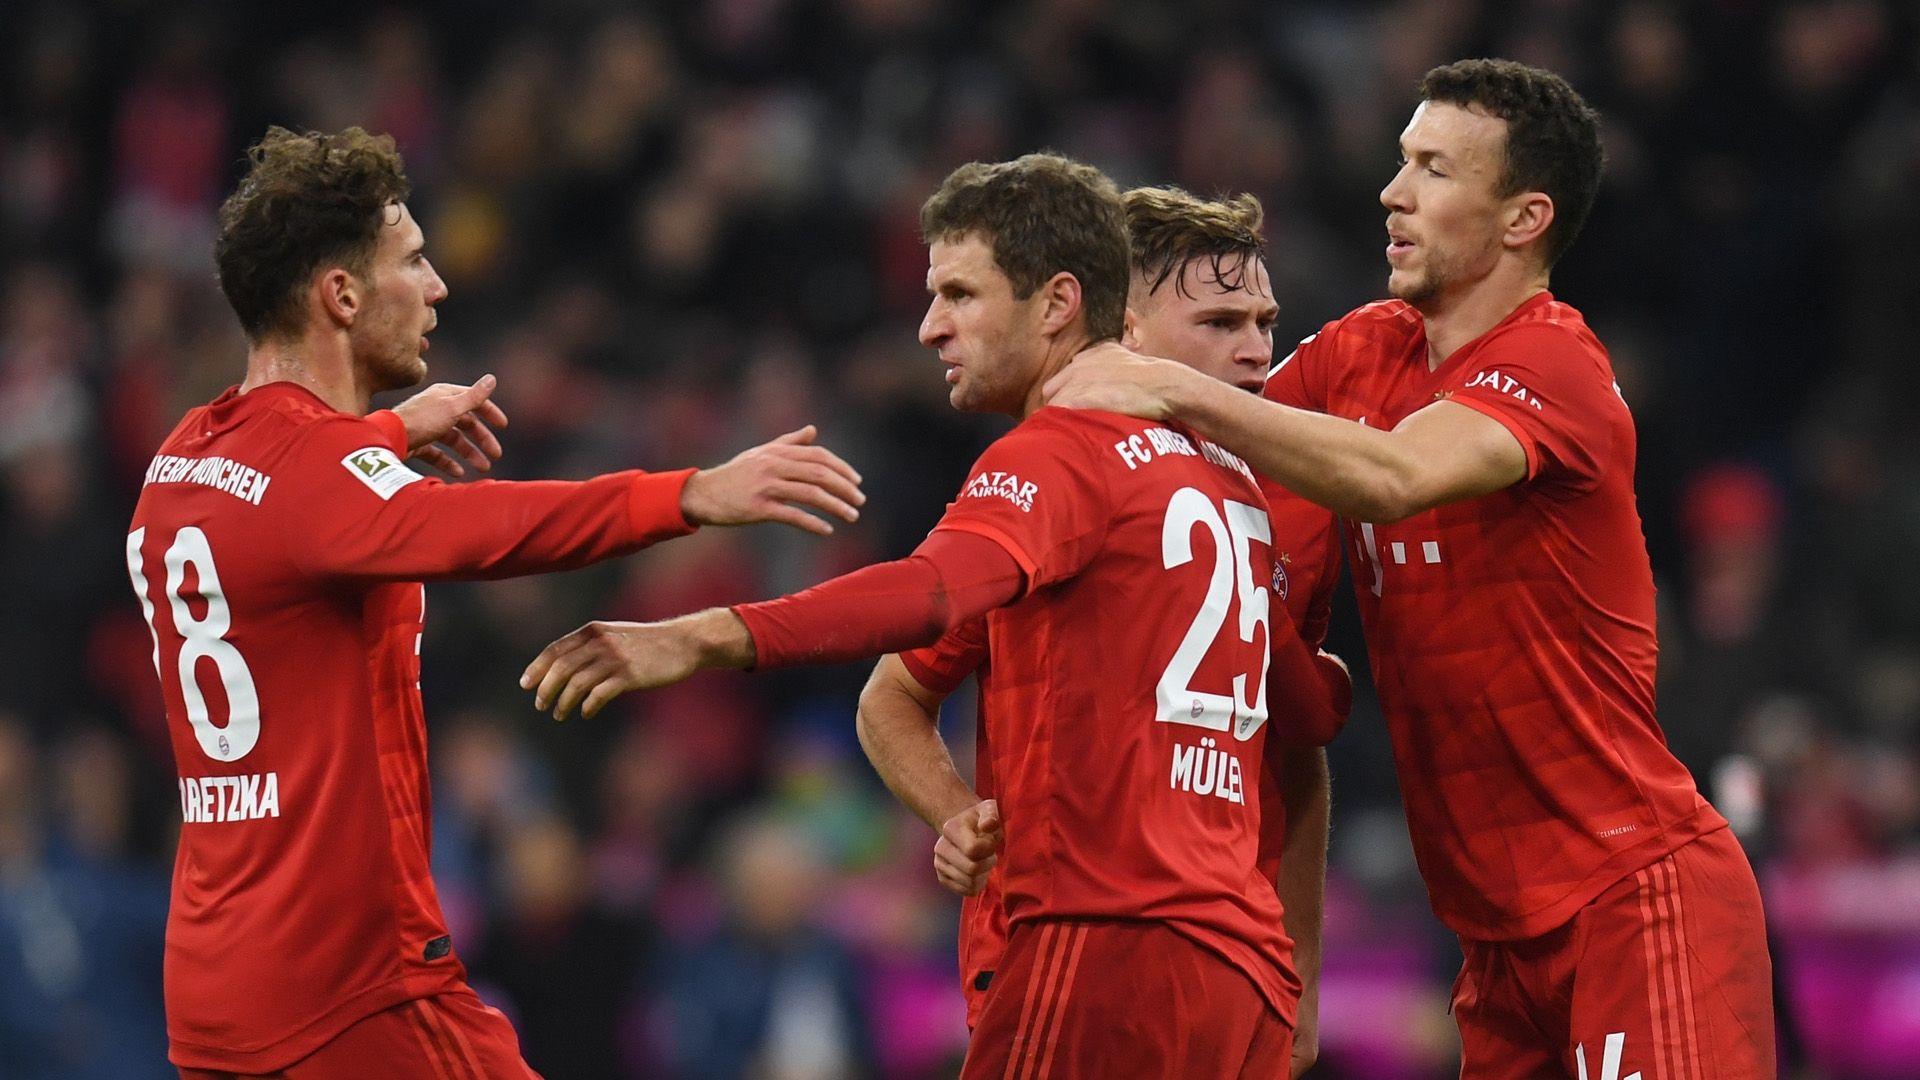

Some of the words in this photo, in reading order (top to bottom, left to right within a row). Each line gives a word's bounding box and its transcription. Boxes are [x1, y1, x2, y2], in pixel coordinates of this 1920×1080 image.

[1114, 434, 1152, 470] FC
[1143, 427, 1198, 456] BAYER
[143, 454, 199, 488] AYERN
[967, 486, 1032, 513] AIRWAYS
[1154, 487, 1272, 742] 25
[1170, 736, 1245, 807] MÜLE
